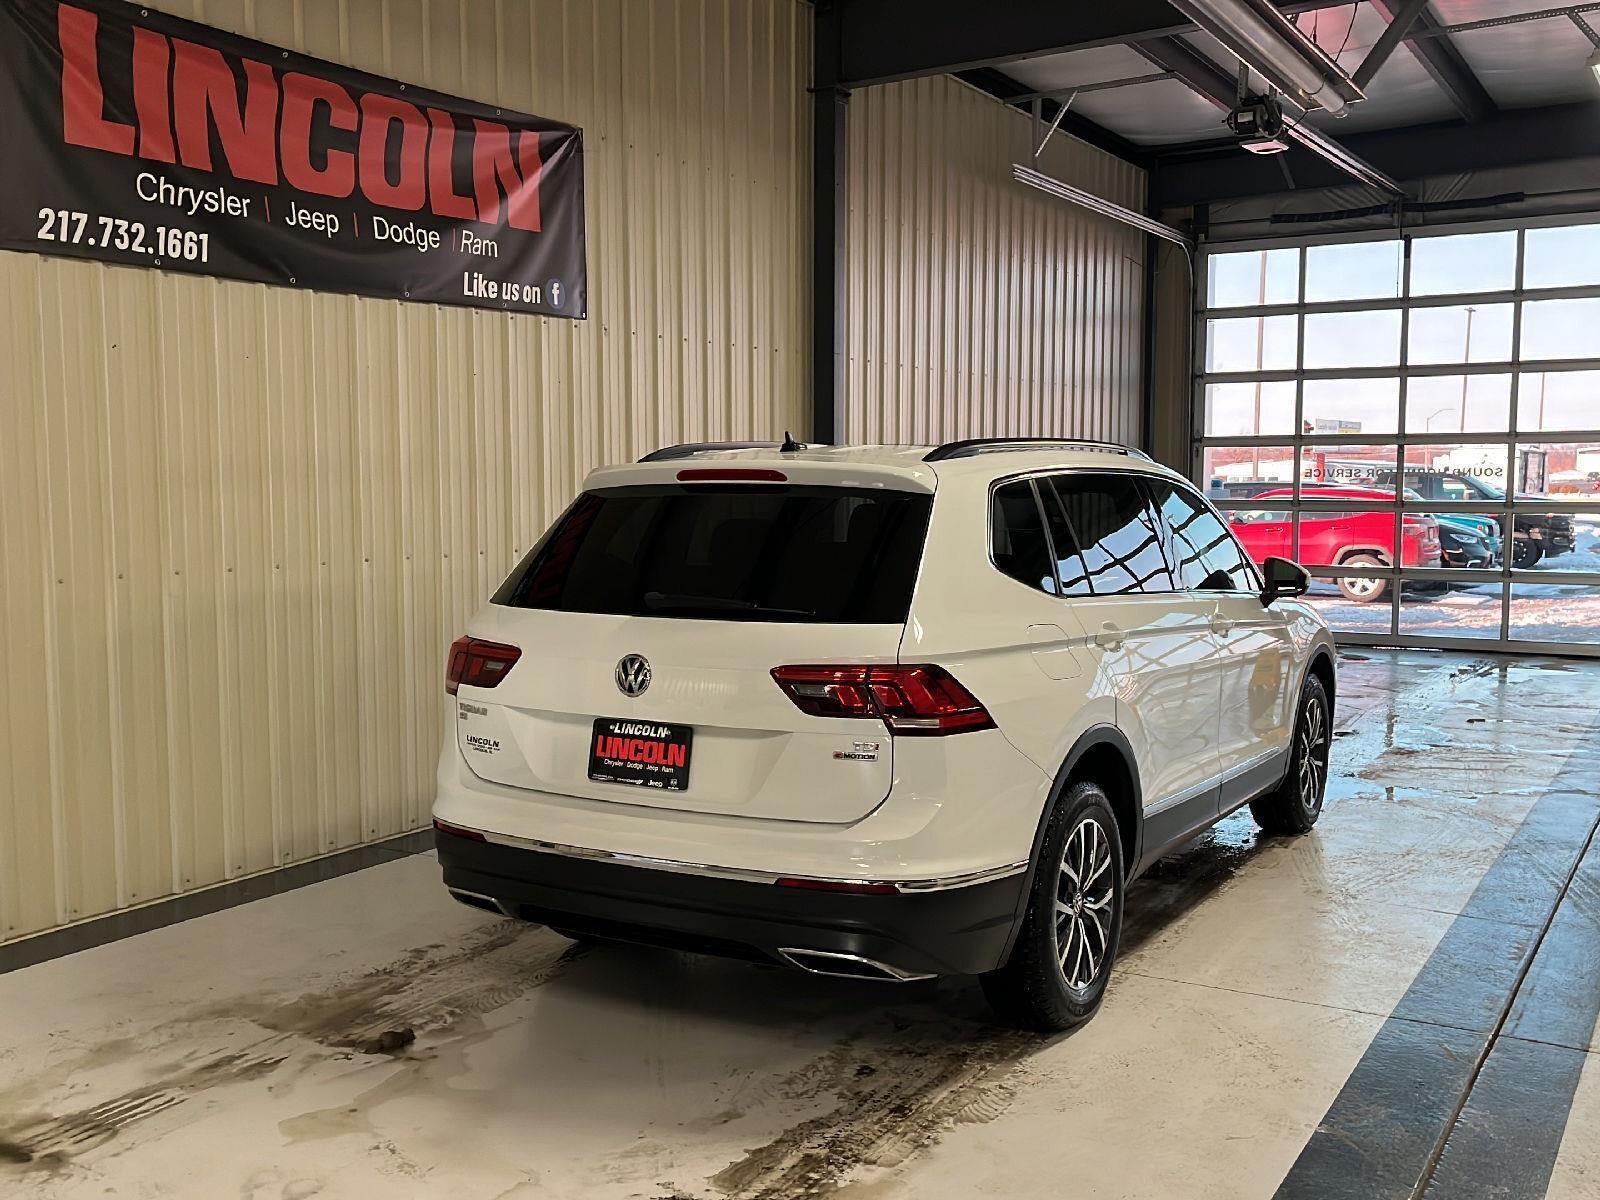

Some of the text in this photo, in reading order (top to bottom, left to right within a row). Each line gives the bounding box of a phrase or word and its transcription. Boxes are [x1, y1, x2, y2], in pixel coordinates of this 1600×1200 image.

[58, 3, 543, 232] LINCOLN
[136, 172, 498, 258] Chrysler Jeep Dodge Ram
[37, 207, 209, 262] 217.732.1661
[463, 271, 498, 299] Like
[502, 282, 519, 301] us
[522, 284, 541, 304] on
[466, 734, 500, 748] LINCOLN
[613, 722, 668, 738] LINCOLN
[596, 735, 686, 767] LINCOLN
[626, 761, 643, 770] Dodge
[646, 763, 659, 772] Jeep
[647, 779, 663, 788] Jeep
